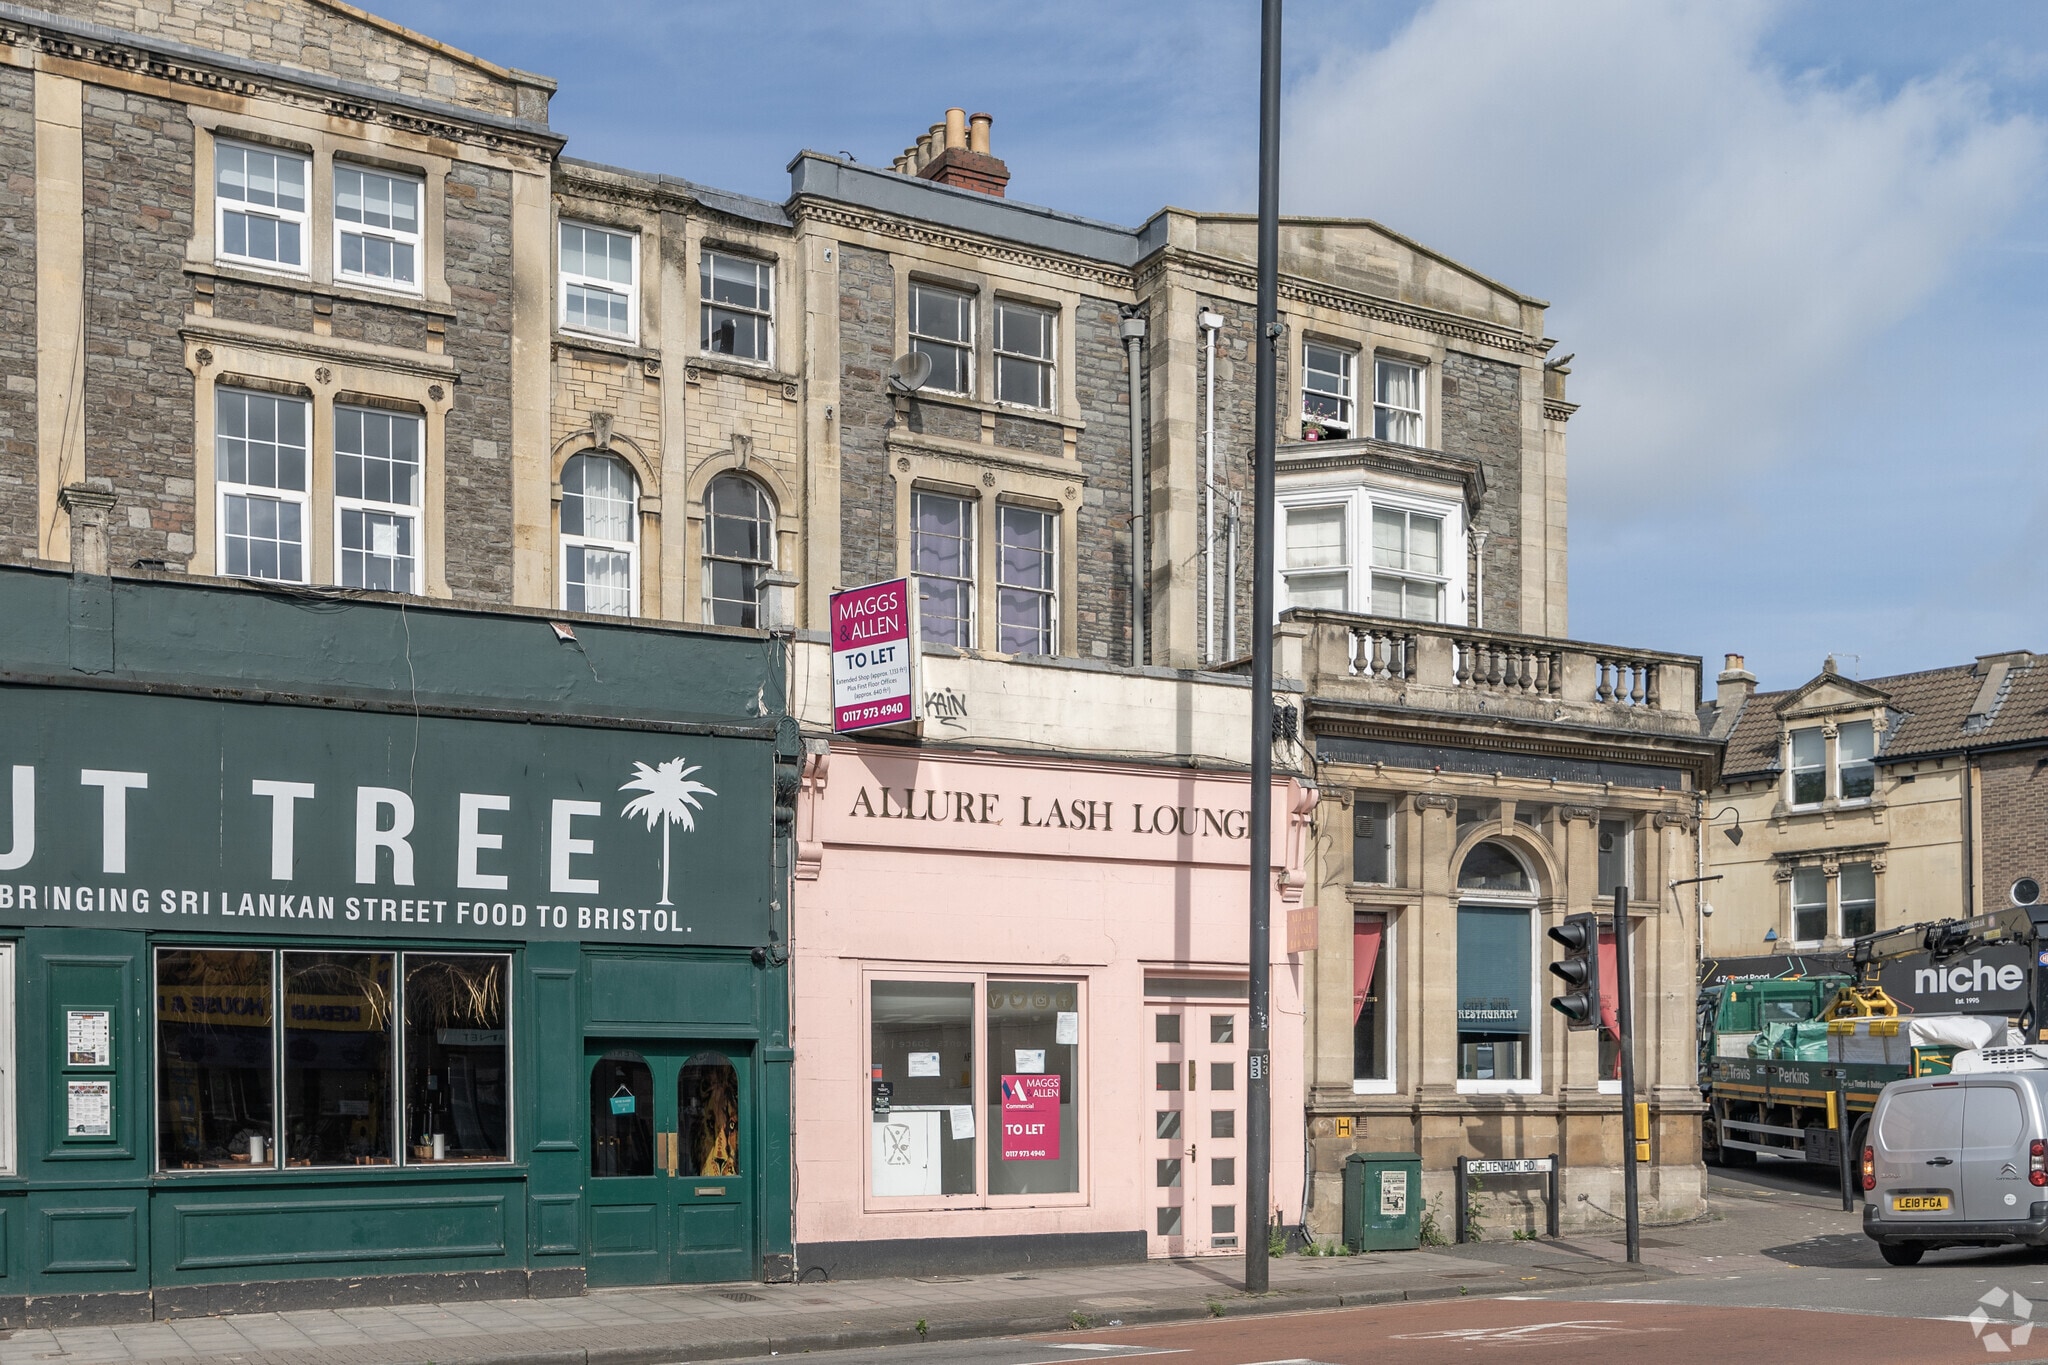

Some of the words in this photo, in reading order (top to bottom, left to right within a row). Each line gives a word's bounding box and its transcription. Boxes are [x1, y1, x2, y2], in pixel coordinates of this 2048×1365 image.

[840, 592, 898, 621] MAGGS
[846, 653, 866, 670] TO
[872, 646, 895, 665] LET
[836, 675, 857, 685] Extended
[881, 678, 897, 686] Offices
[843, 710, 861, 722] 0117
[863, 706, 879, 719] 973
[880, 702, 903, 716] 4940
[849, 786, 1004, 826] ALLURE
[1020, 796, 1113, 832] LASH
[1132, 804, 1251, 839] LOUNG
[252, 780, 601, 894] TREE
[0, 884, 149, 913] BRINGING
[161, 889, 209, 915] SRI
[221, 892, 334, 919] LANKAN
[345, 897, 447, 923] STREET
[457, 902, 526, 926] FOOD
[536, 905, 567, 928] TO
[578, 907, 692, 932] BRISTOL.
[1915, 959, 2023, 994] niche
[1458, 1010, 1518, 1019] RESTAURANT
[1729, 1064, 1750, 1080] Travis
[1779, 1067, 1809, 1084] Perkins
[1026, 1079, 1059, 1087] MAGGS
[1033, 1089, 1059, 1097] ALLEN
[1005, 1124, 1023, 1135] TO
[1026, 1124, 1045, 1135] LET
[1338, 1120, 1349, 1135] H
[1469, 1161, 1520, 1172] CHELTENHAM
[1899, 1198, 1920, 1208] LE18
[1923, 1197, 1942, 1208] FGA
